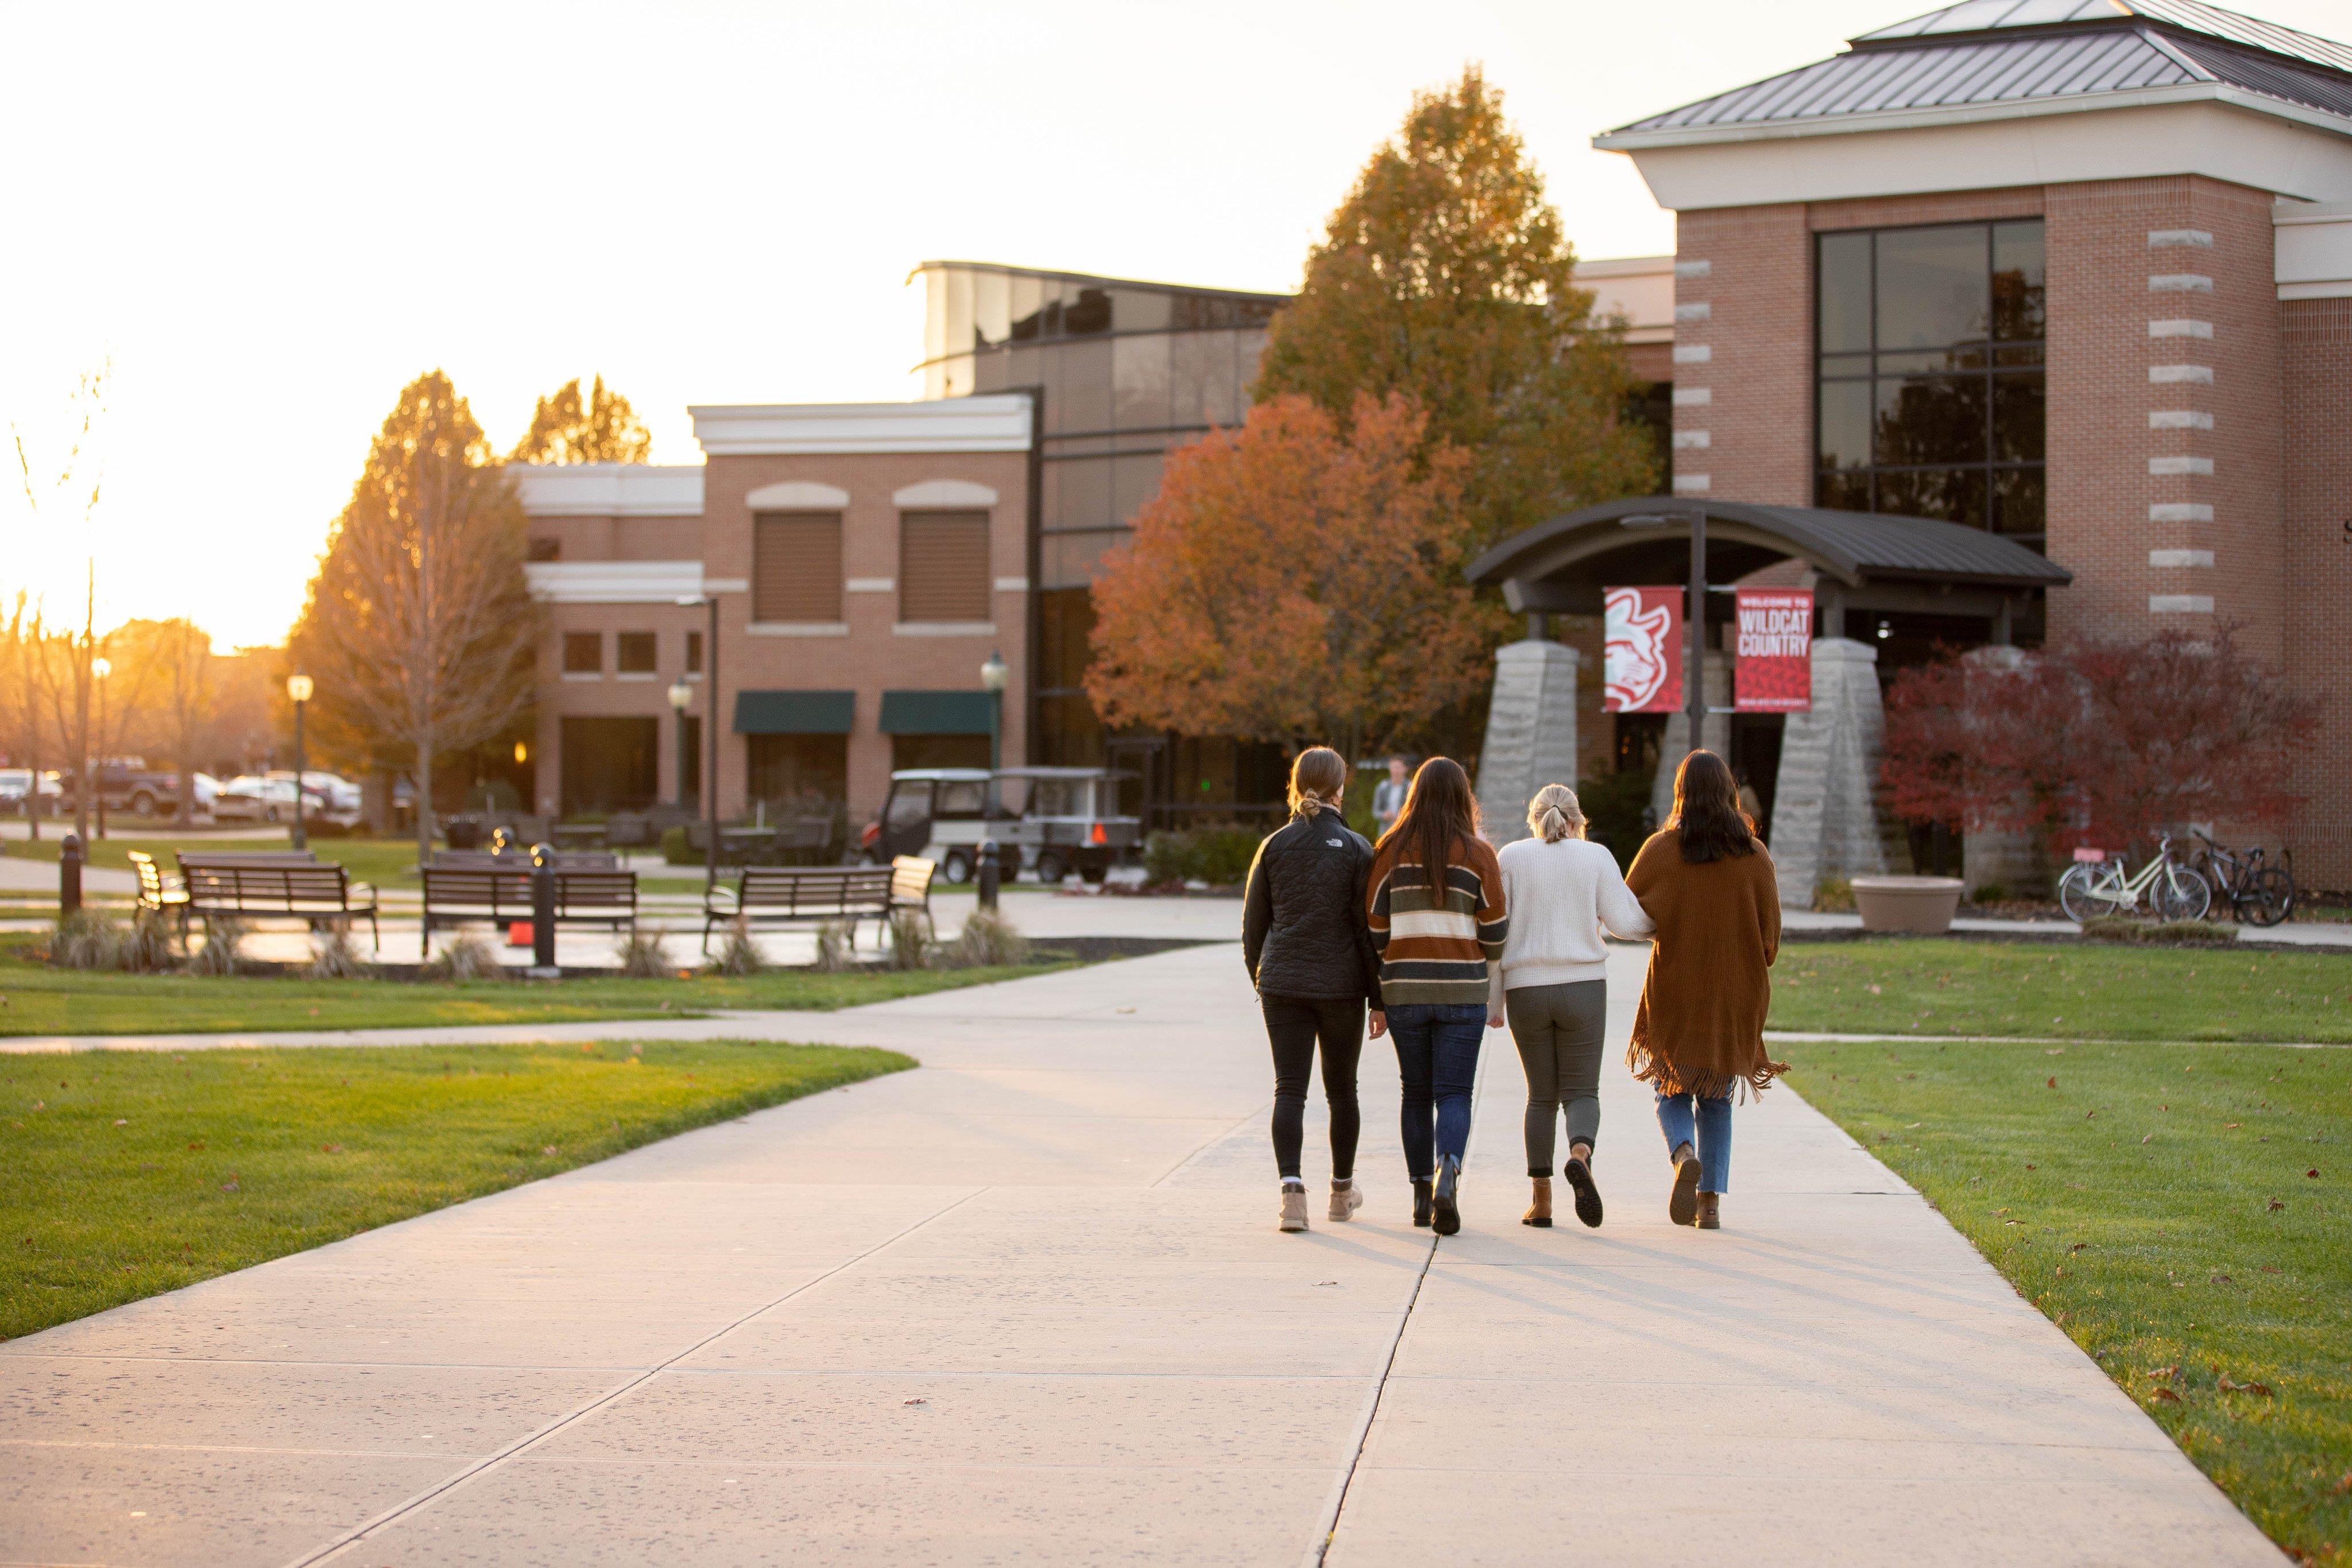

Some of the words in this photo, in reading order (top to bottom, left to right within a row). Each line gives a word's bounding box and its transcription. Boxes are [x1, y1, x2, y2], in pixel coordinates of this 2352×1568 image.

[1740, 597, 1792, 607] WELCOME
[1794, 597, 1809, 607] TO
[1739, 610, 1809, 634] WILDCAT
[1739, 634, 1810, 657] COUNTRY
